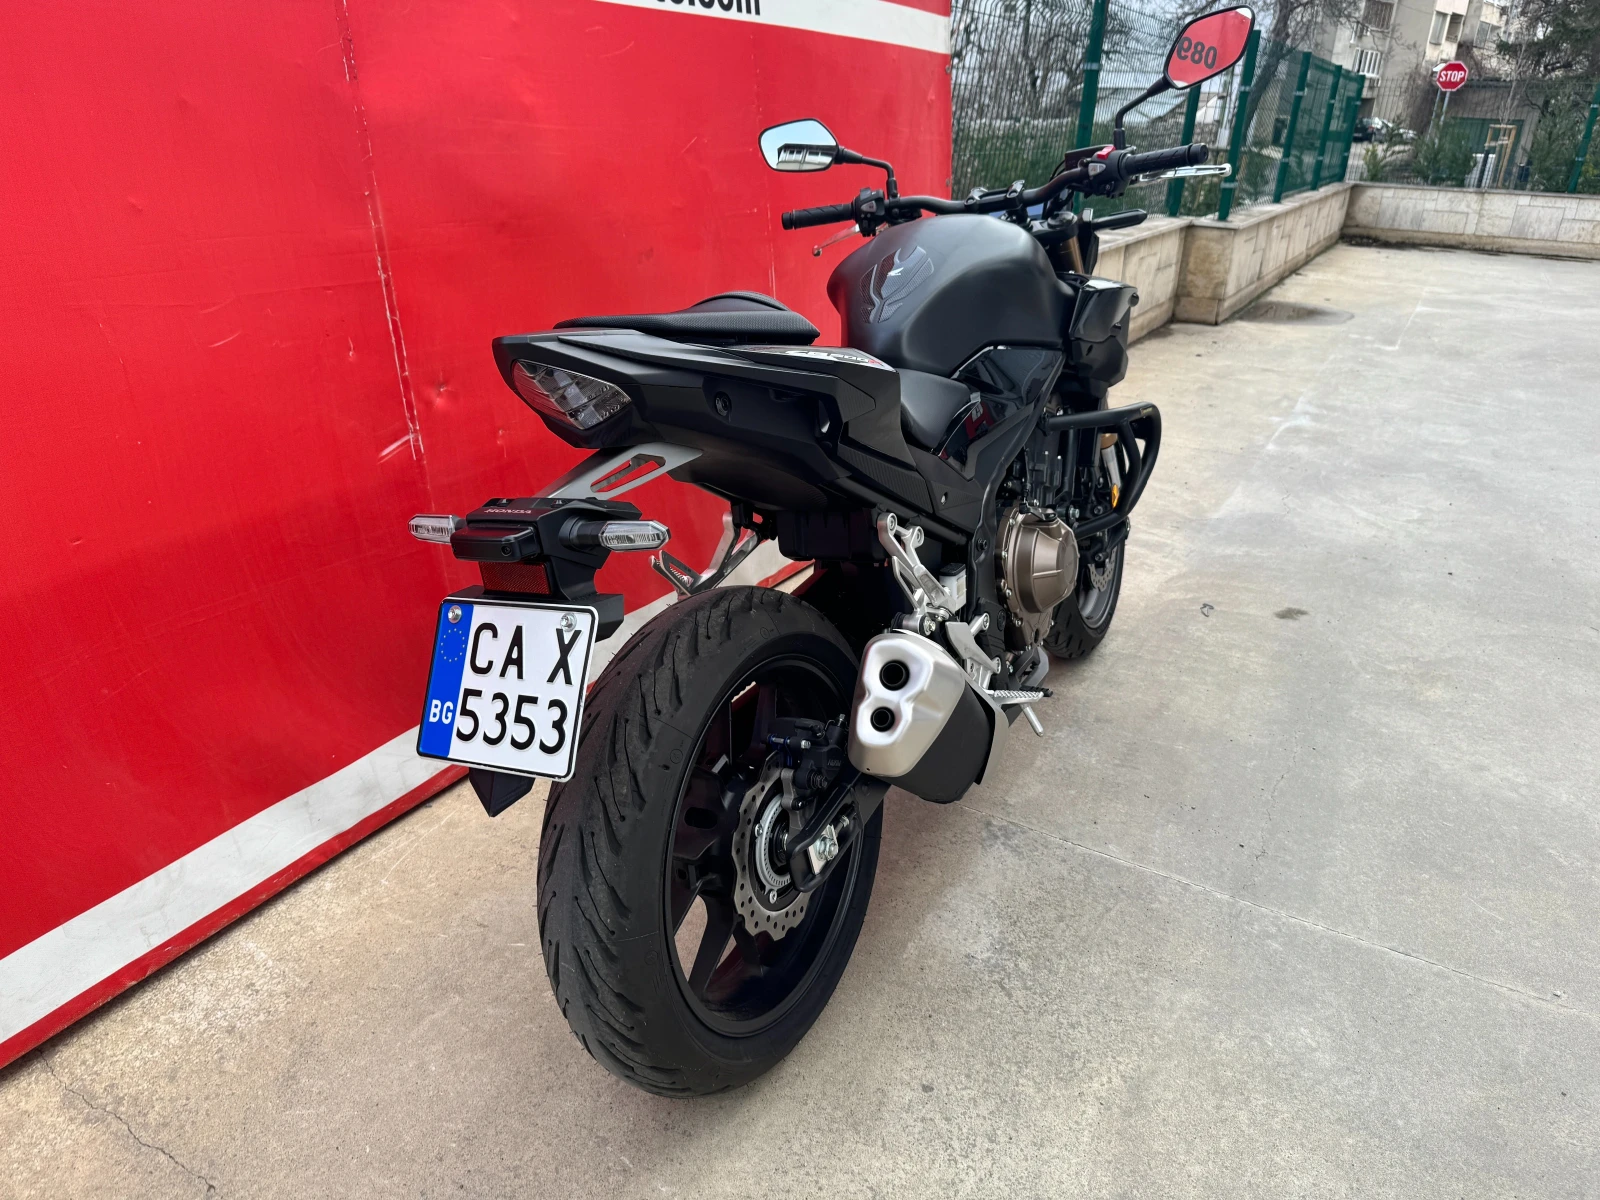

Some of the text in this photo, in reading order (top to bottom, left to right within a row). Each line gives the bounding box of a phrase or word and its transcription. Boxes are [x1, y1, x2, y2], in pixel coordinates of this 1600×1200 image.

[1439, 70, 1465, 82] STOP
[470, 622, 582, 686] CA X
[429, 699, 454, 725] BG
[456, 687, 568, 755] 5353
